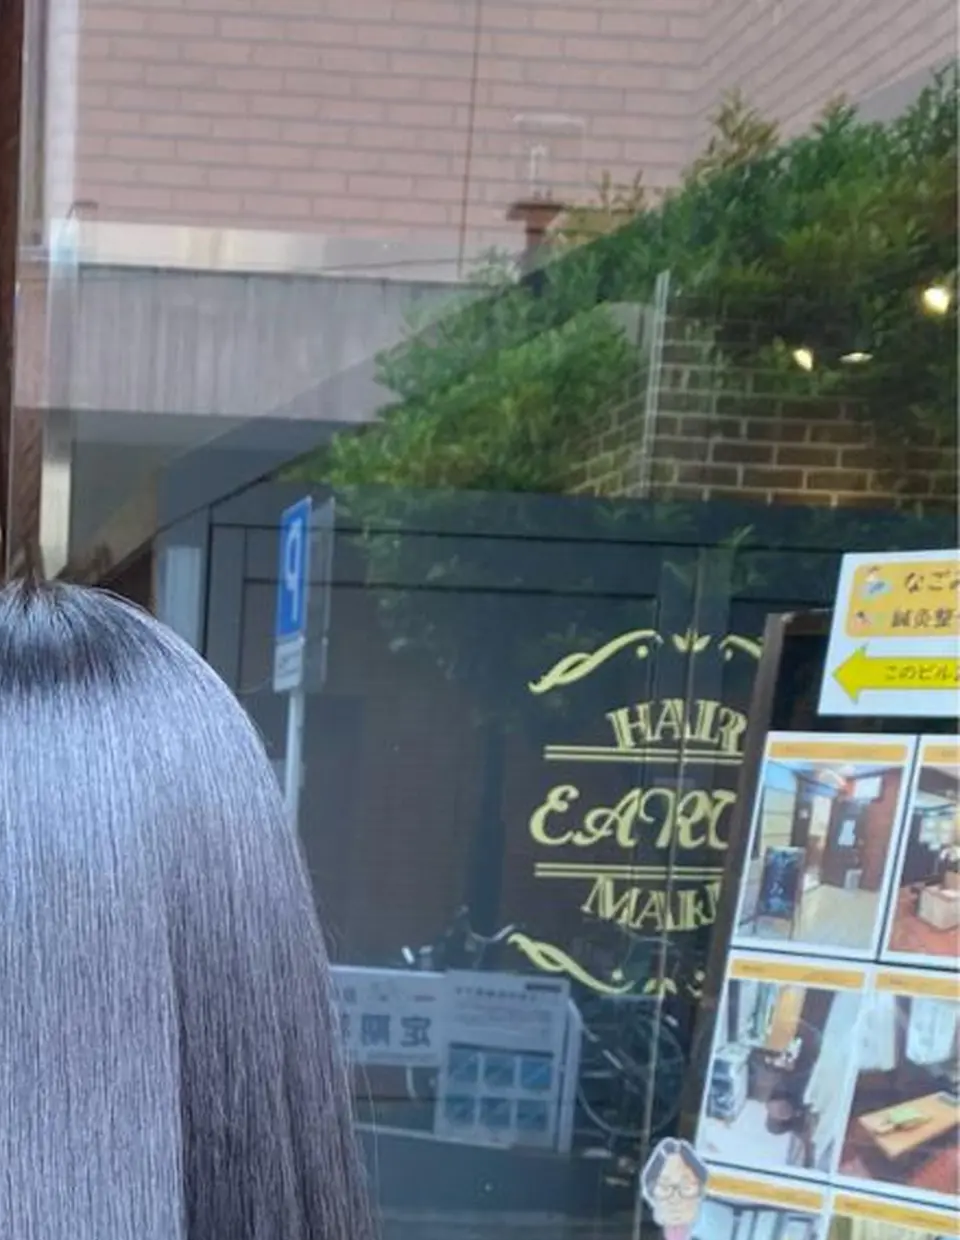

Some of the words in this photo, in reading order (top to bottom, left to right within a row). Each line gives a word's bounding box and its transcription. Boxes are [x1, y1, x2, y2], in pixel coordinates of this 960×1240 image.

[891, 607, 959, 628] 鍼灸整
[884, 662, 959, 682] このビル
[606, 698, 747, 751] HAIR
